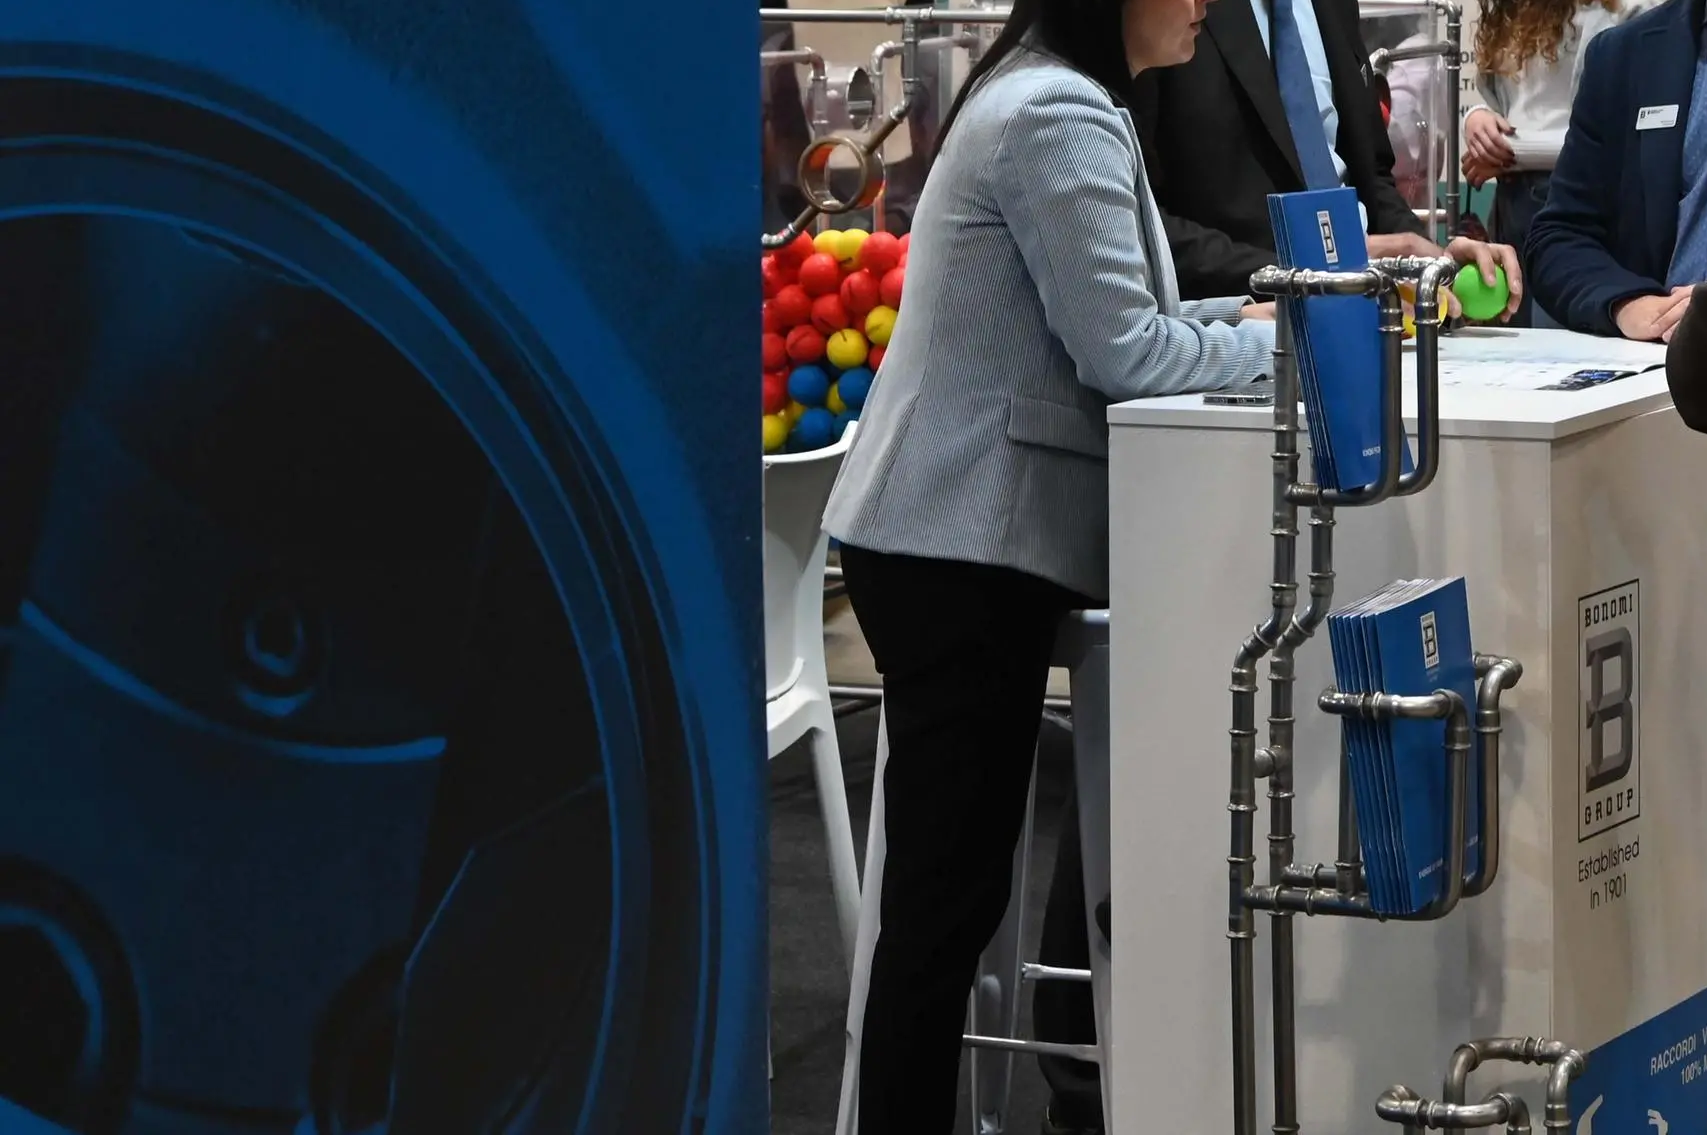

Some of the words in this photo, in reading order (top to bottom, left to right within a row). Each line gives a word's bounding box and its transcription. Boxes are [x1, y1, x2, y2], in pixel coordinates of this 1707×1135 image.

[1584, 593, 1634, 627] BONOMI
[1585, 626, 1633, 793] B
[1584, 787, 1634, 826] GROUP
[1578, 834, 1640, 882] Established
[1603, 872, 1627, 904] 1901
[1650, 1036, 1697, 1076] RACCORDI
[1680, 1058, 1702, 1086] 100%
